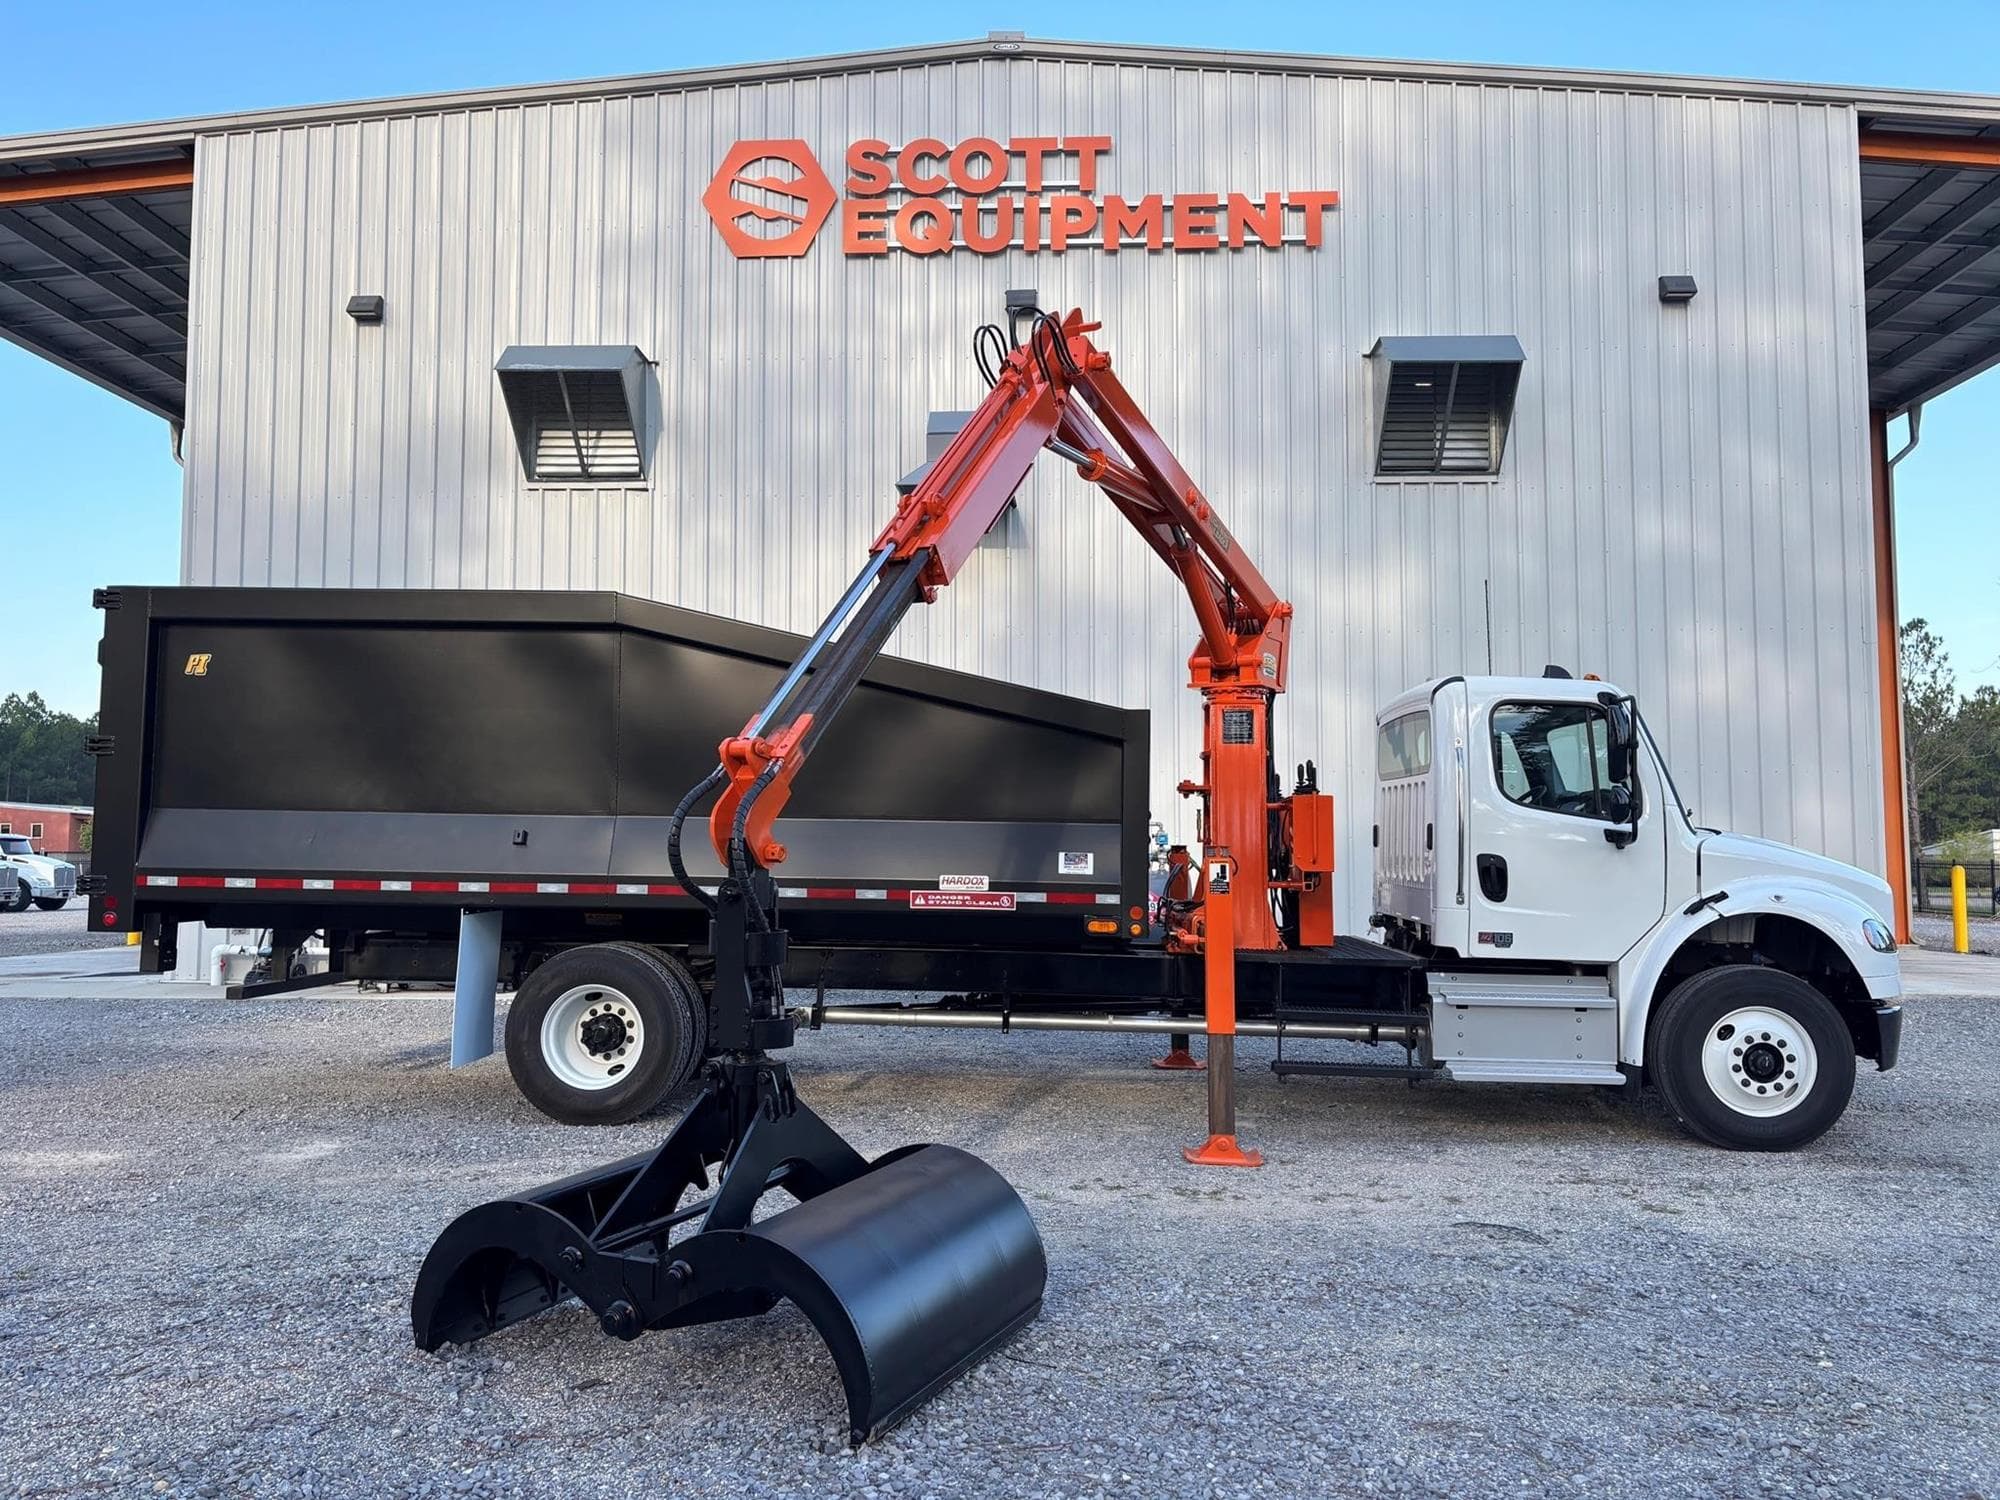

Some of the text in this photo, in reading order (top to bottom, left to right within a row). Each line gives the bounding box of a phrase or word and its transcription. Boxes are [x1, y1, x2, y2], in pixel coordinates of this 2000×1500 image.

[844, 135, 1112, 196] SCOTT
[842, 190, 1339, 255] EQUIPMENT
[941, 876, 984, 886] HARDOX
